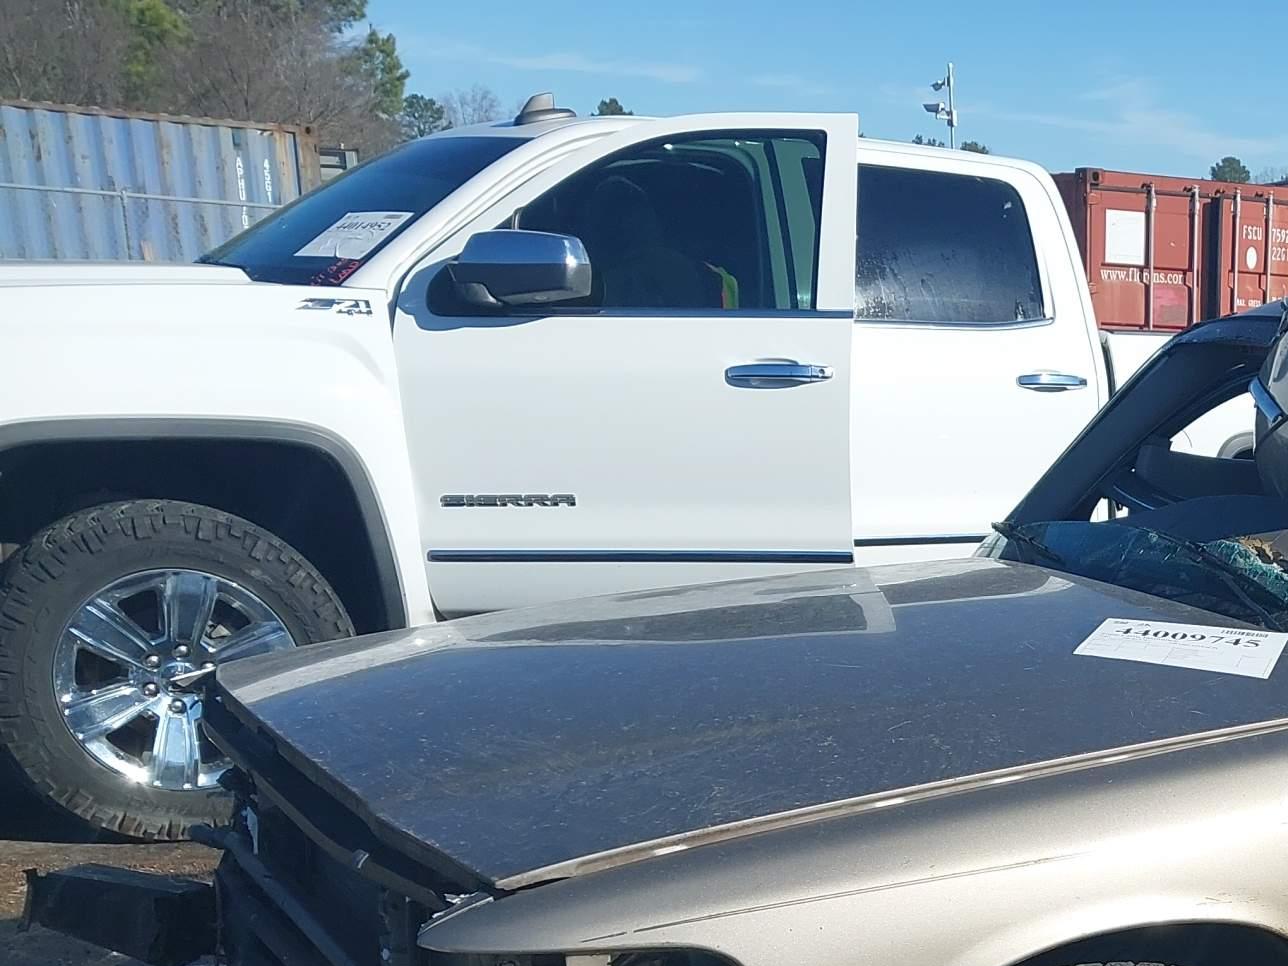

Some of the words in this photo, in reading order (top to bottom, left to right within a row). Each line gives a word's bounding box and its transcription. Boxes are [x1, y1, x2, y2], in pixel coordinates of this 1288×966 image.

[236, 157, 246, 201] APHU
[1243, 225, 1262, 241] FSCU
[440, 494, 577, 507] SIERRA
[1115, 627, 1262, 648] 44009745
